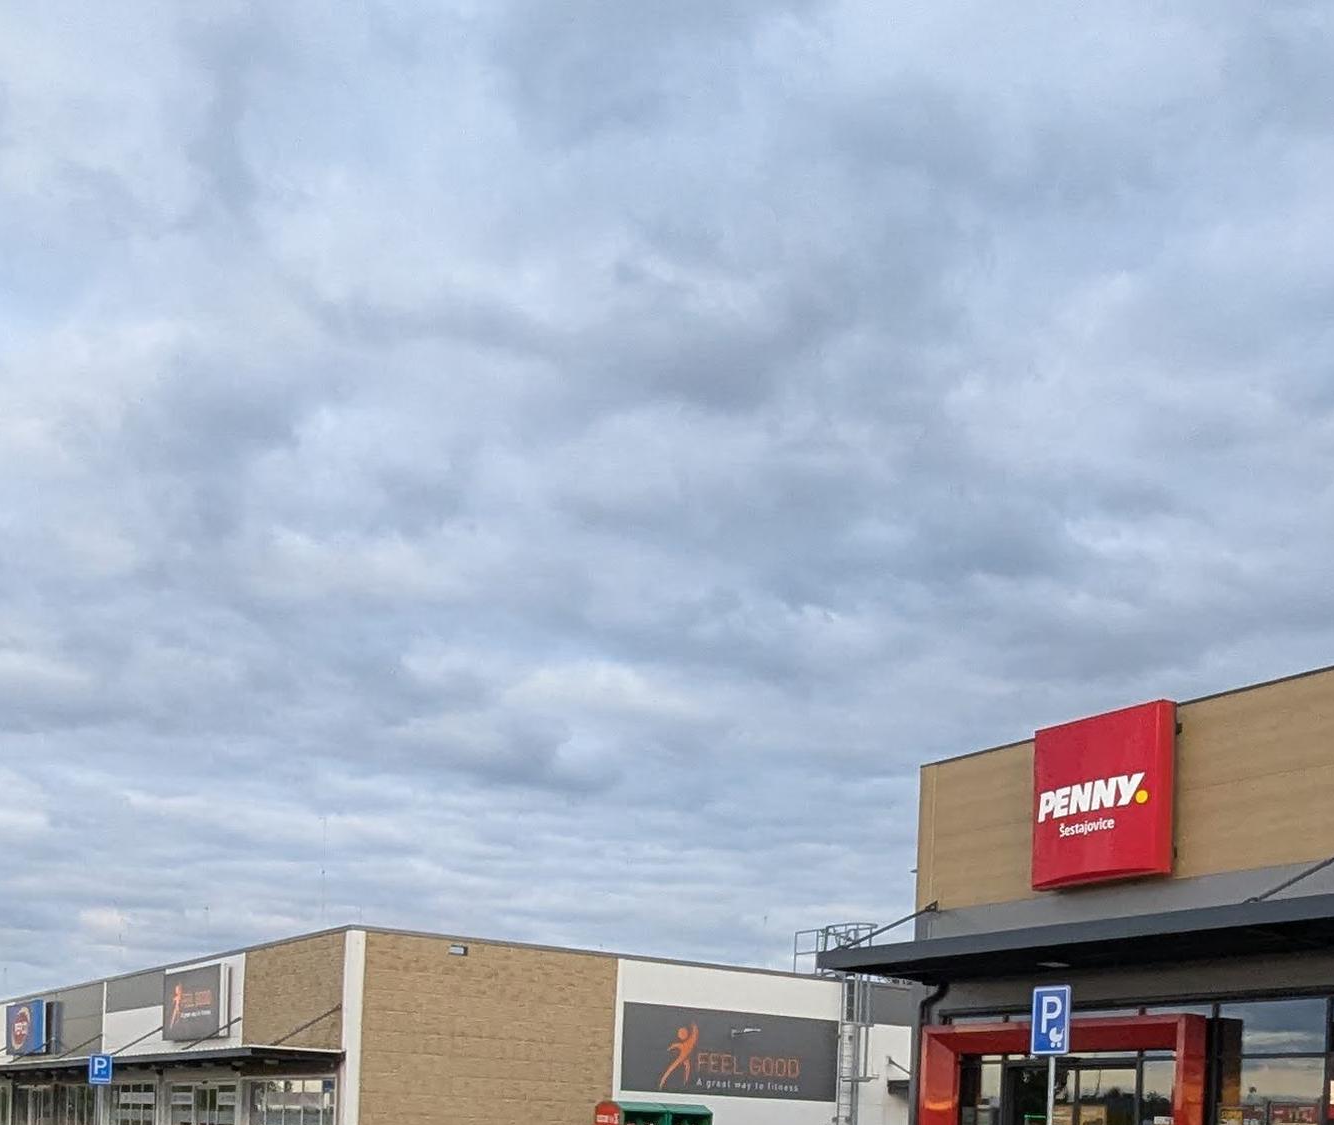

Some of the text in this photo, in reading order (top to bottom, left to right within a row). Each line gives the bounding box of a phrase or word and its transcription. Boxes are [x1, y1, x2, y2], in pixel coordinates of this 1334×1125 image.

[1058, 818, 1116, 838] Šestajovice
[1041, 996, 1062, 1034] P
[94, 1057, 107, 1075] P
[696, 1052, 800, 1079] FEEL GOOD
[696, 1078, 799, 1093] A great way to fitness
